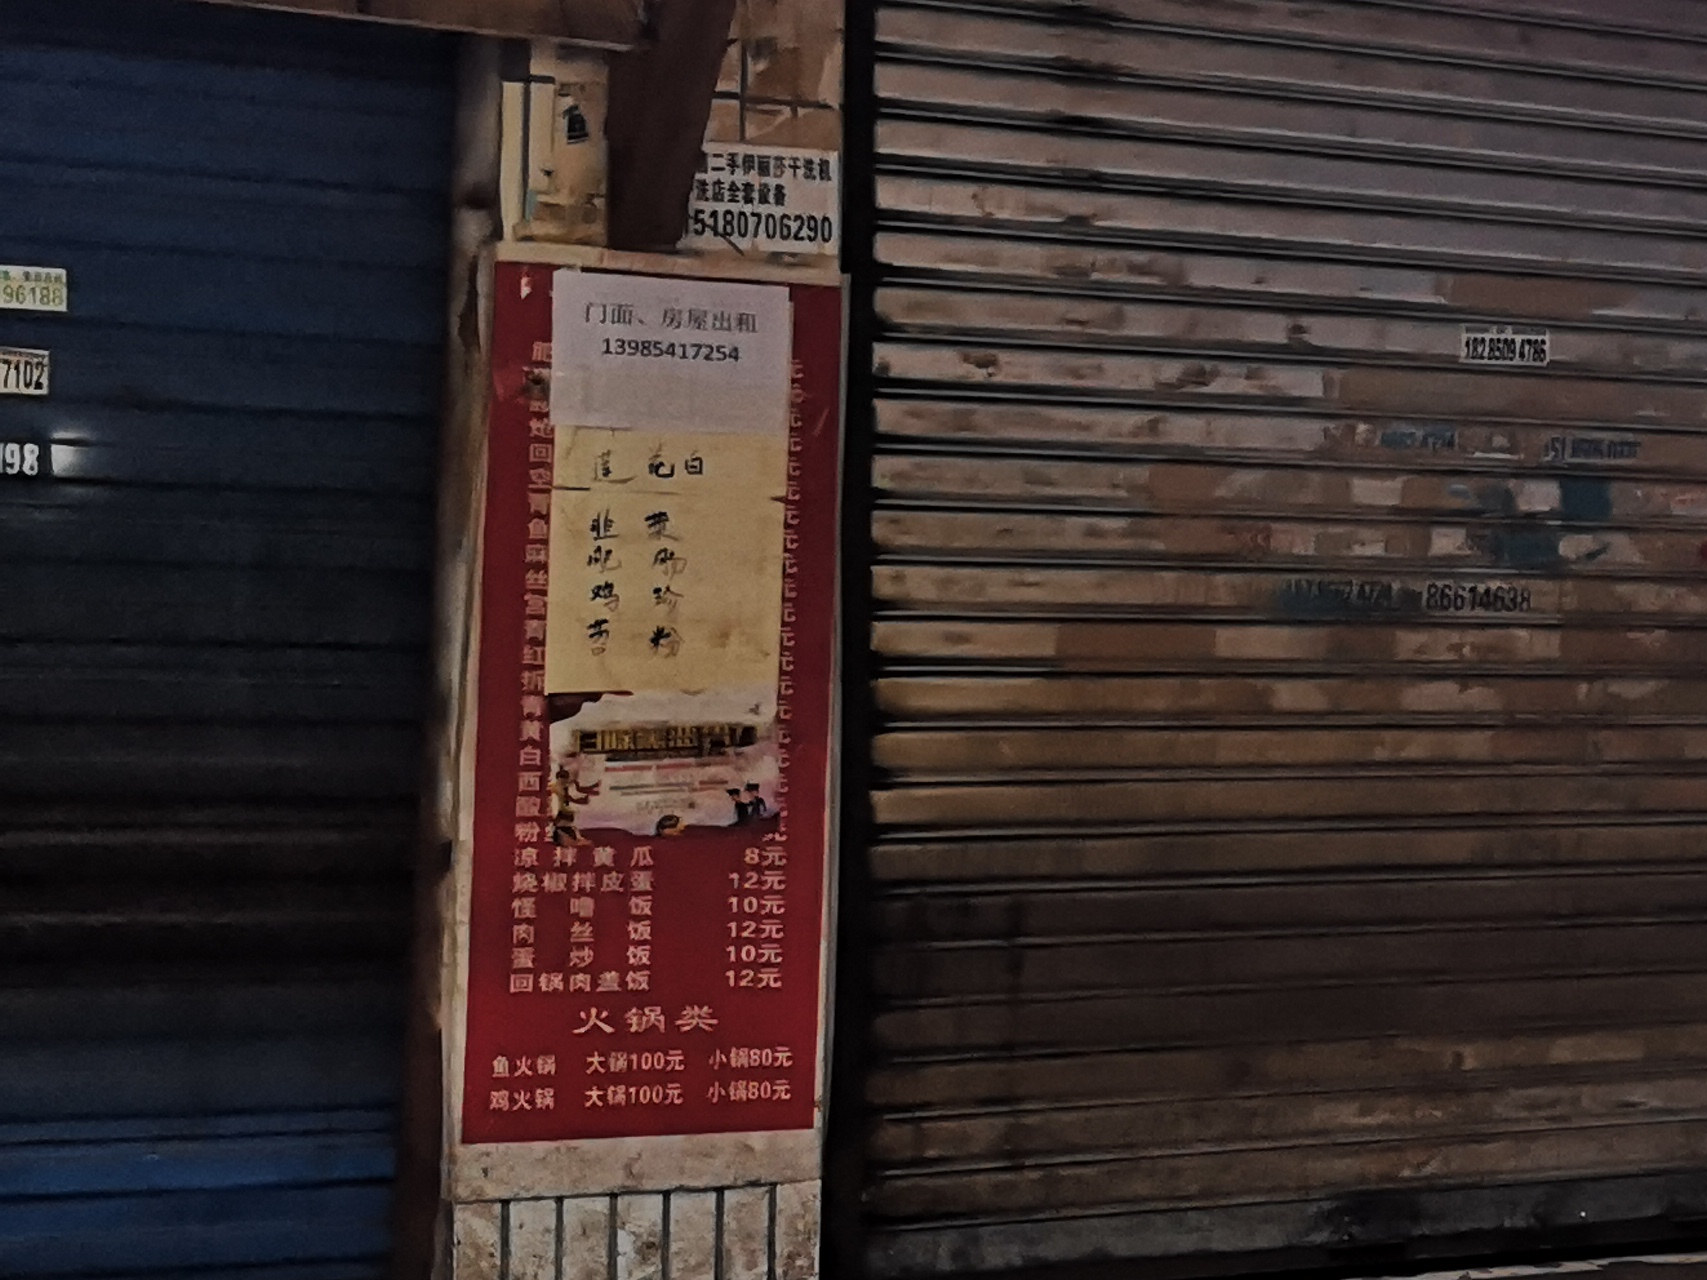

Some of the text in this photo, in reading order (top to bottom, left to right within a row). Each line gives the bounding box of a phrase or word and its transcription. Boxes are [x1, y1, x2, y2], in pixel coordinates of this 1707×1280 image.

[601, 338, 741, 361] 13985417254
[727, 870, 788, 891] 12元
[726, 895, 786, 916] 10元
[726, 919, 785, 940] 12元
[725, 943, 783, 965] 10元
[725, 967, 783, 989] 12元
[571, 1004, 720, 1035] 火锅类
